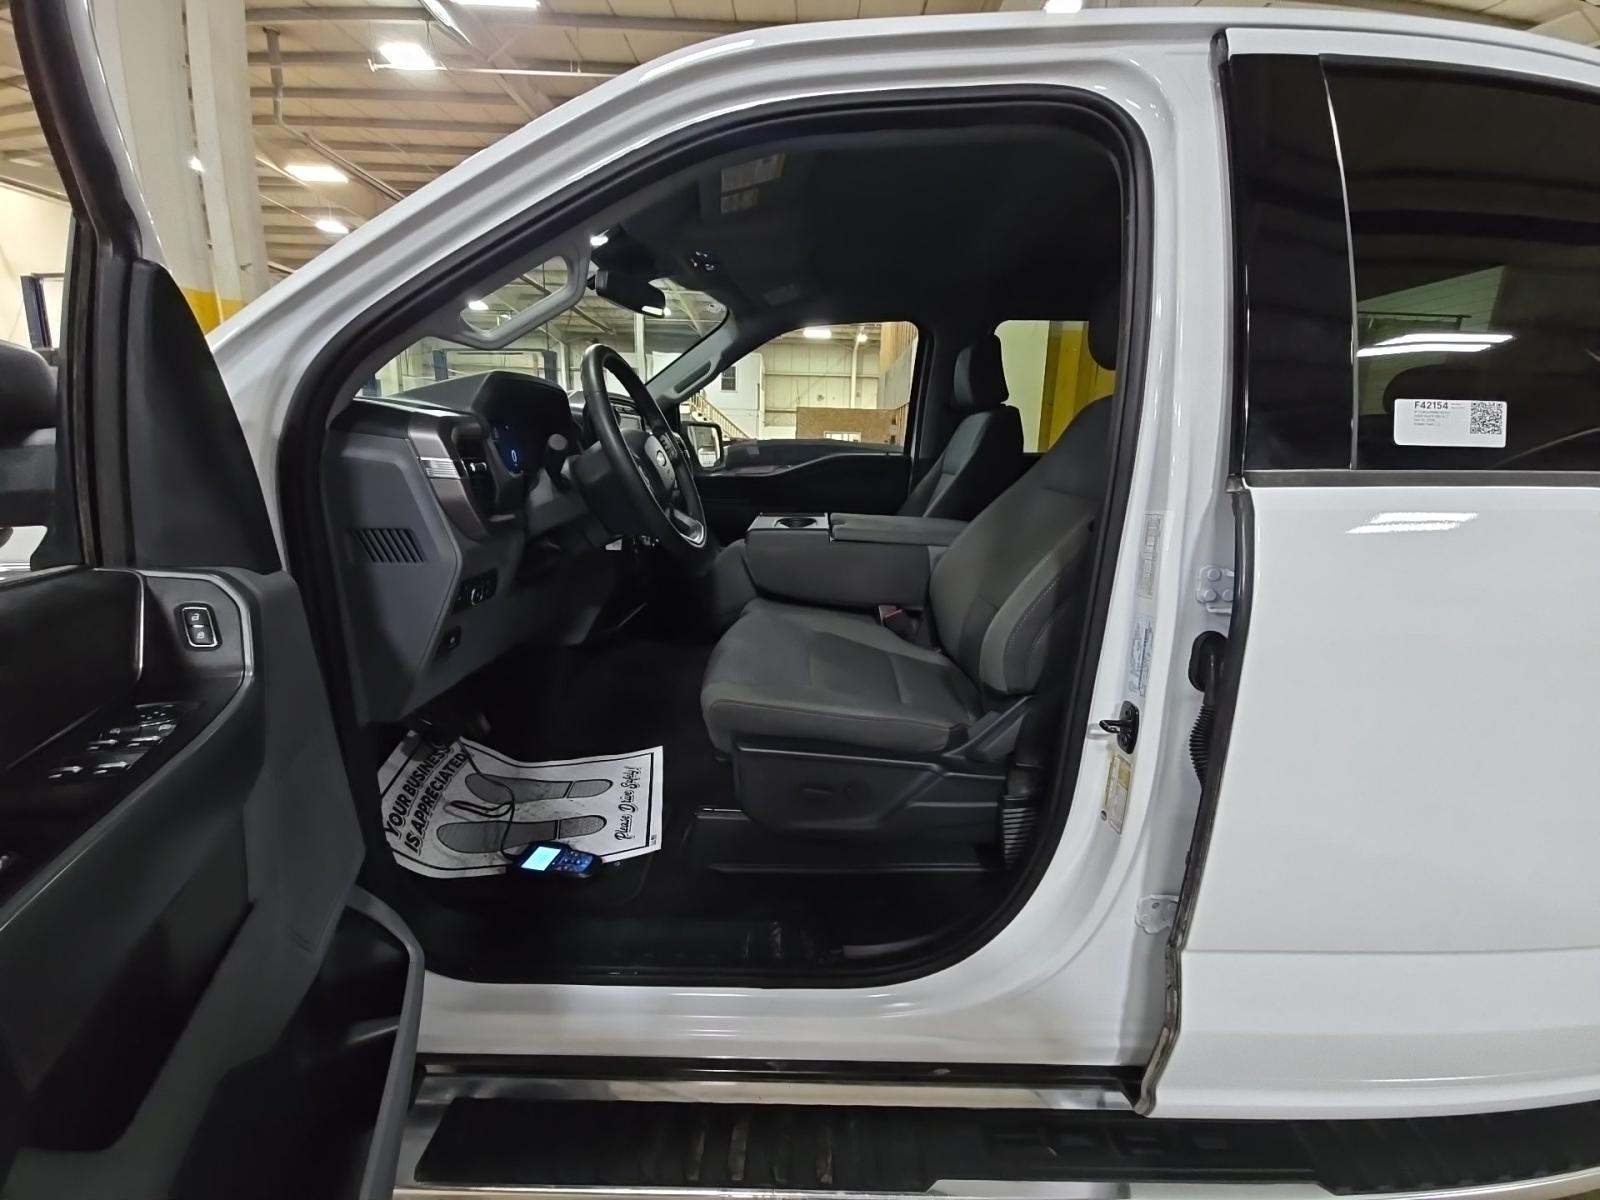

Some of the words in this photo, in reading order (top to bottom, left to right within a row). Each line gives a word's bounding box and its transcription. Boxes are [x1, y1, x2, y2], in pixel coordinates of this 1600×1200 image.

[1414, 401, 1449, 410] F42154
[384, 793, 411, 836] YOUR
[402, 744, 450, 797] BUSINESS
[618, 790, 636, 812] Drive
[614, 813, 632, 840] Please
[404, 832, 420, 854] IS
